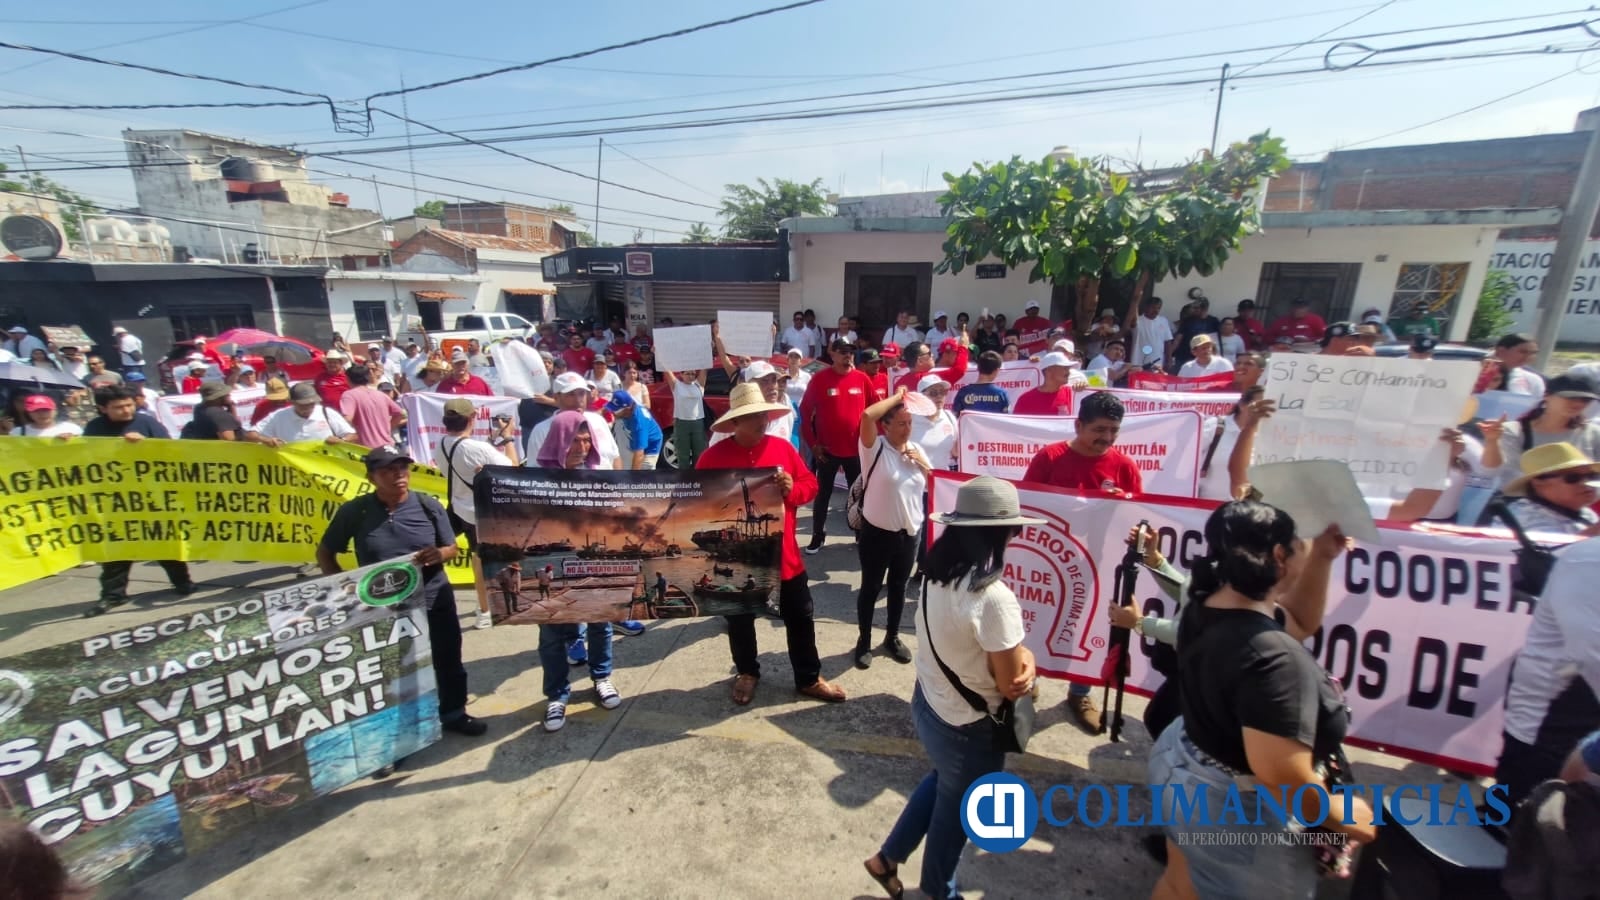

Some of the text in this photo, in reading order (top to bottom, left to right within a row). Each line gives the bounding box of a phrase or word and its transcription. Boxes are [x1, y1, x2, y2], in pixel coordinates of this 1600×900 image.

[1272, 361, 1297, 381] Si
[964, 393, 999, 405] Corona
[978, 442, 1024, 454] DESTRUIR
[1027, 443, 1039, 454] LA
[1112, 441, 1167, 456] UYUTLÁN
[978, 456, 988, 467] ES
[135, 461, 249, 485] PRIMERO
[258, 464, 350, 497] NUESTRO
[518, 488, 547, 497] mientras
[555, 490, 577, 498] puerto
[578, 490, 587, 498] de
[587, 490, 622, 498] Manzanillo
[622, 491, 646, 499] empuja
[561, 481, 568, 489] la
[569, 482, 592, 491] Laguna
[593, 482, 602, 490] de
[631, 482, 657, 490] custodia
[693, 481, 701, 489] de
[0, 490, 185, 531] STENTABLE,
[196, 490, 271, 514] HACER
[279, 493, 316, 518] UNO
[550, 499, 563, 507] que
[573, 499, 594, 507] olvida
[25, 519, 191, 557] PROBLEMAS
[1018, 526, 1076, 563] EROS
[1003, 563, 1052, 586] AL DE
[1066, 564, 1082, 580] DE
[1022, 609, 1037, 622] DE
[1068, 582, 1086, 620] COLIMA
[83, 583, 321, 657] PESCADORES
[205, 625, 228, 644] Y
[69, 611, 348, 705] ACUACULTORES
[1407, 636, 1487, 718] DE
[0, 616, 423, 777] SALVEMOS LA
[25, 655, 385, 809] LAGUNA DE
[27, 685, 387, 845] CUYUTLAN!
